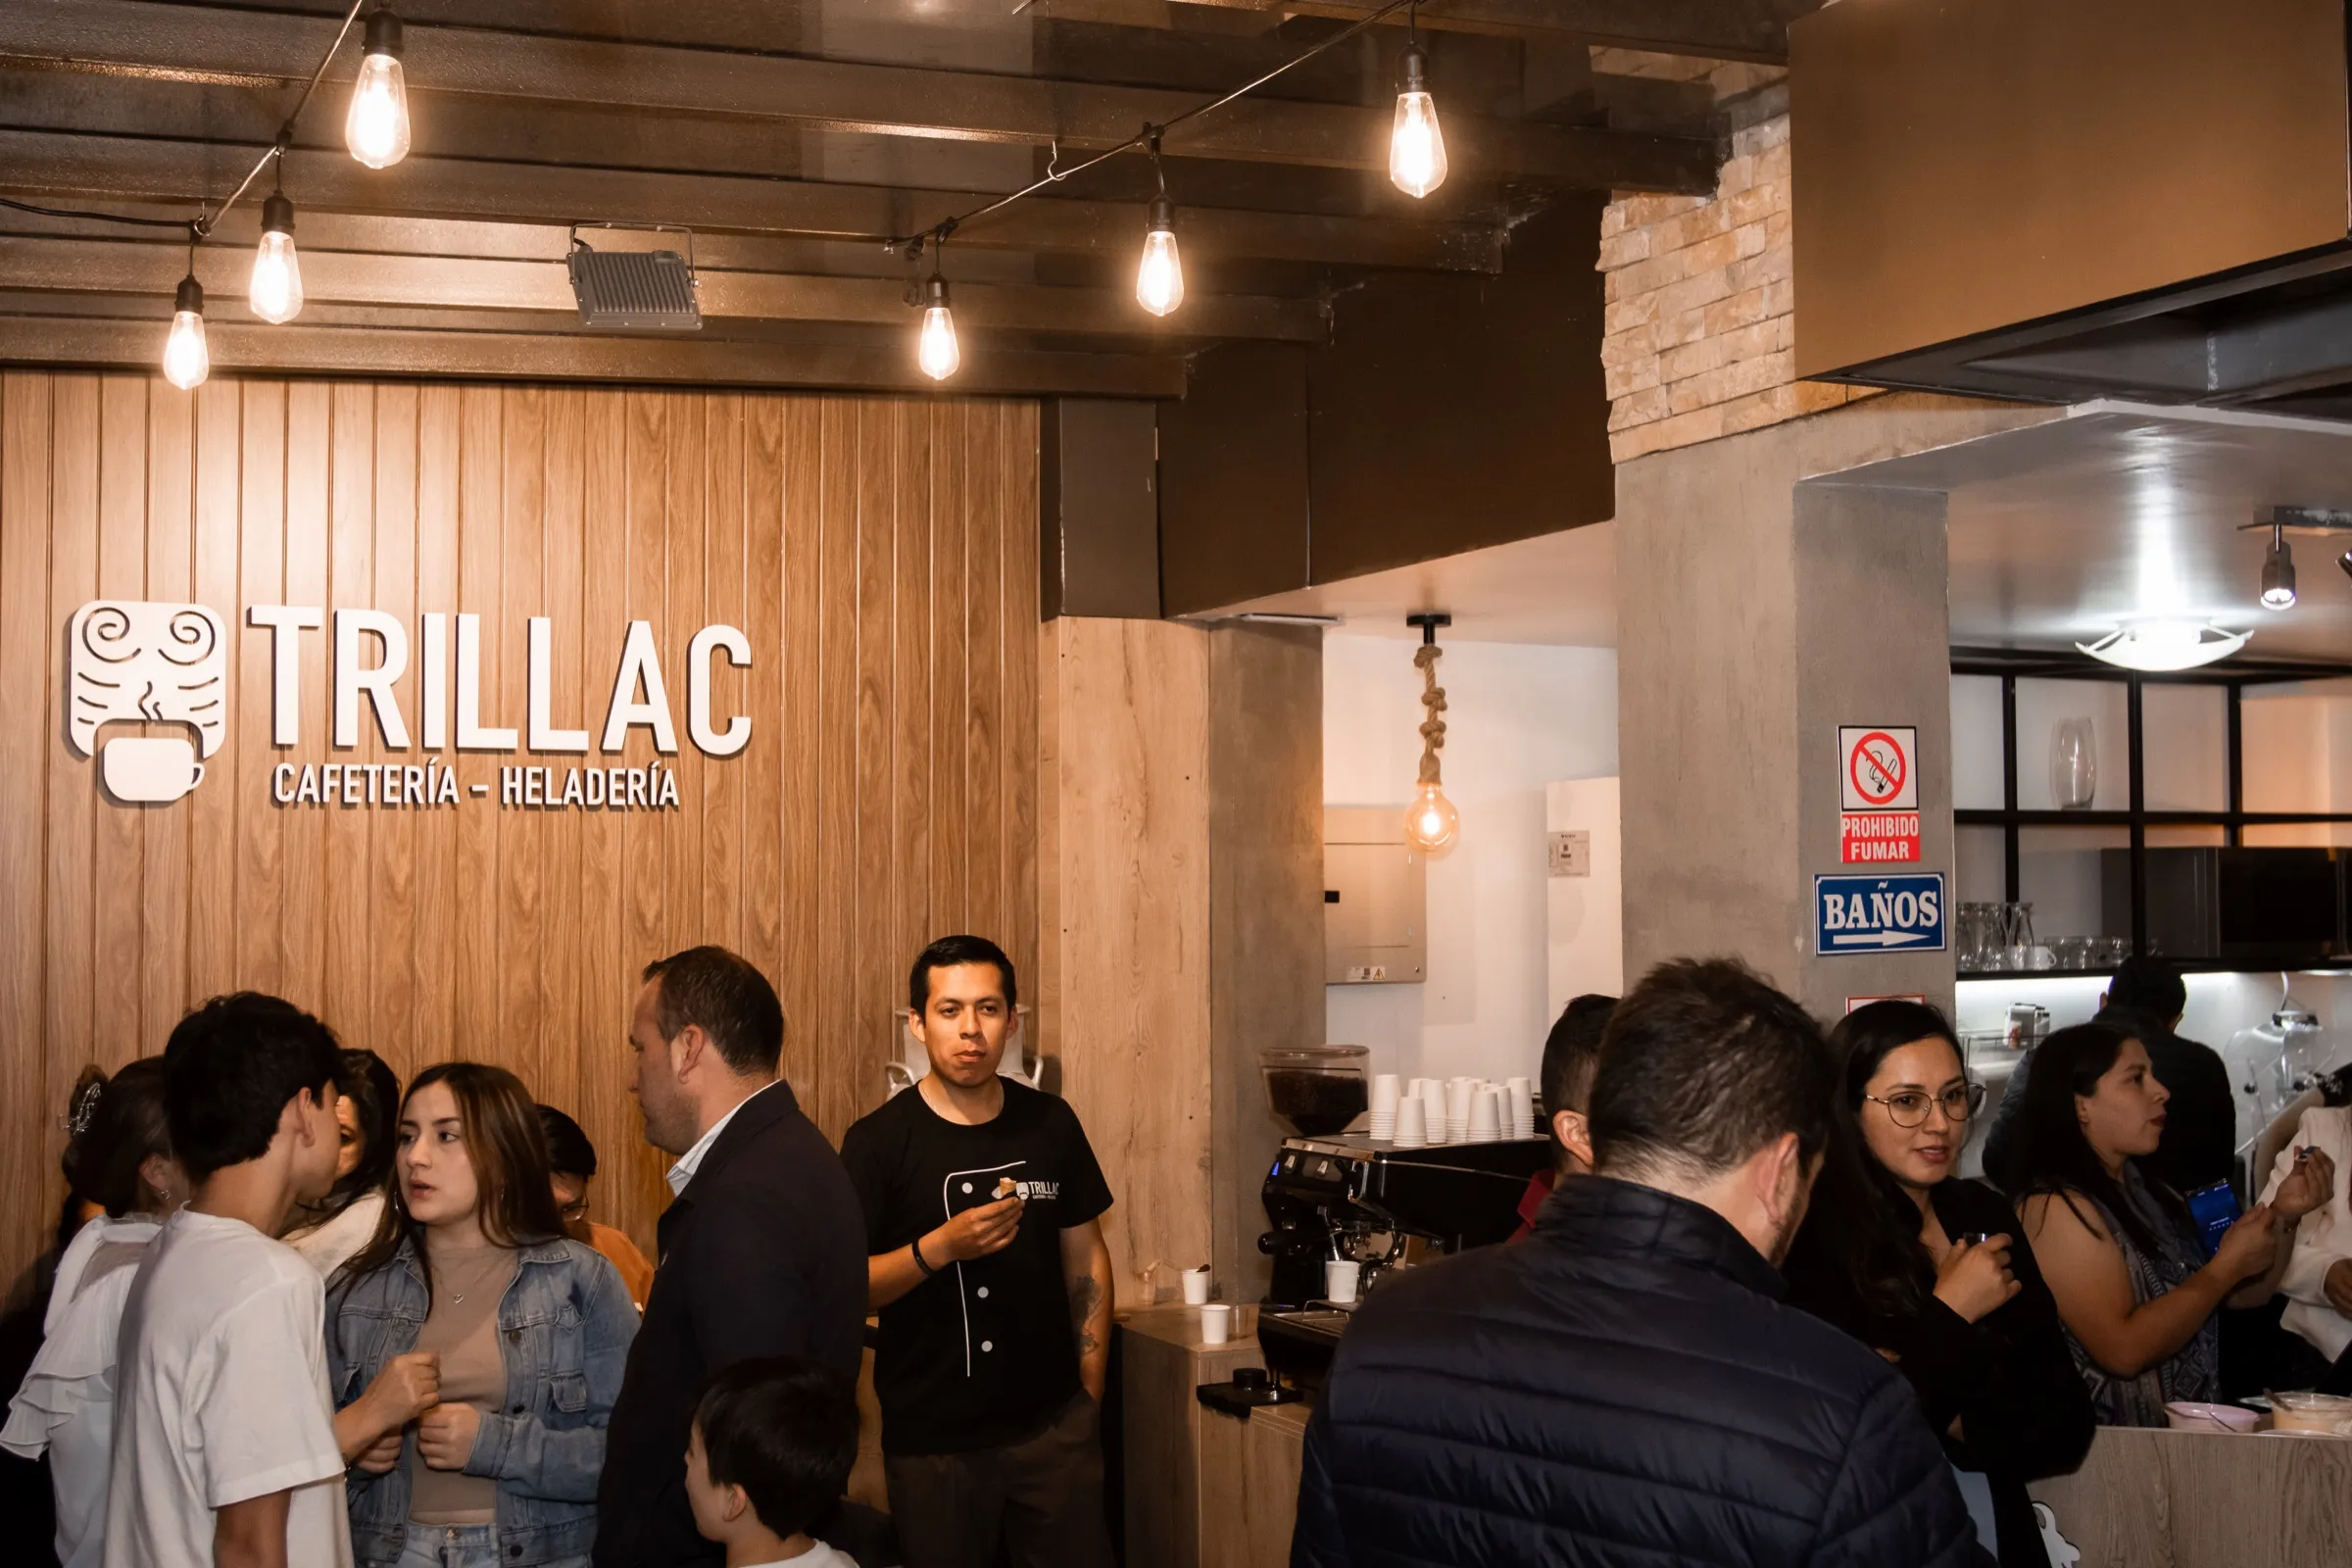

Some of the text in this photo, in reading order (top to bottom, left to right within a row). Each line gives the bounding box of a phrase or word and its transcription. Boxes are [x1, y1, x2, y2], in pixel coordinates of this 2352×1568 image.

[248, 605, 753, 757] TRILLAC
[273, 758, 460, 805] CAFETERÍA
[501, 761, 679, 808] HELADERÍA
[1842, 816, 1919, 838] PROHIBIDO
[1851, 841, 1909, 860] FUMAR
[1824, 881, 1938, 930] BAÑOS
[1028, 1181, 1059, 1196] TRILLAC
